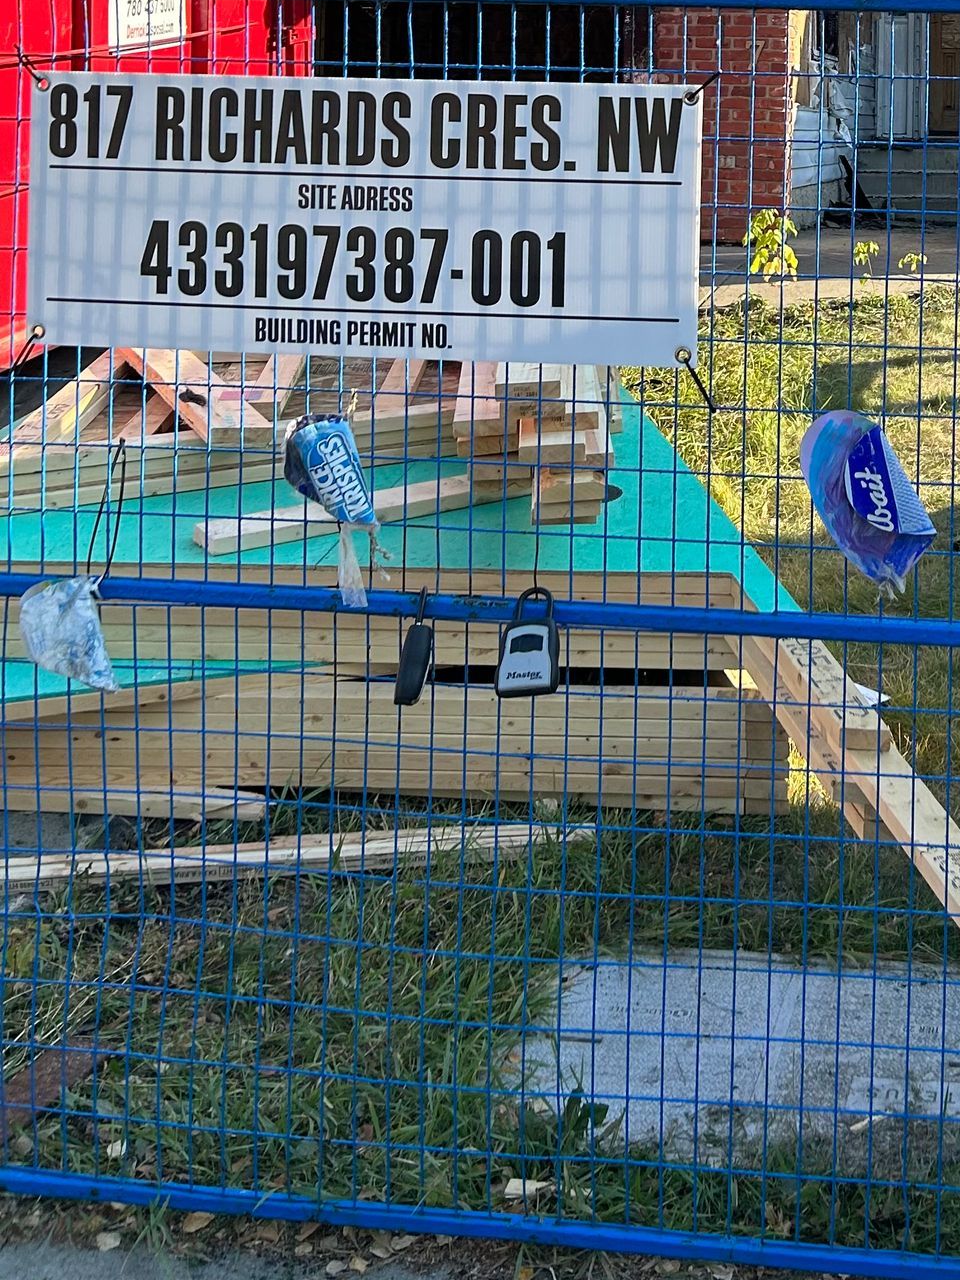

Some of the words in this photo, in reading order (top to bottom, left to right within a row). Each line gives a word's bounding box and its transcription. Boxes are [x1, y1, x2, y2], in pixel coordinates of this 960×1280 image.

[126, 0, 142, 17] 780
[50, 84, 134, 160] 817
[156, 87, 412, 168] RICHARDS
[430, 93, 577, 173] CRES.
[597, 97, 683, 174] NW
[298, 184, 337, 210] SITE
[341, 186, 413, 212] ADRESS
[140, 220, 566, 308] 433197387-001
[255, 318, 341, 346] BUILDING
[347, 321, 417, 348] PERMIT
[421, 324, 453, 349] NO.
[311, 462, 344, 510] RICE
[324, 436, 371, 519] KRISPIES
[854, 466, 895, 532] bait
[505, 671, 542, 680] Master
[863, 1086, 957, 1106] TEUS
